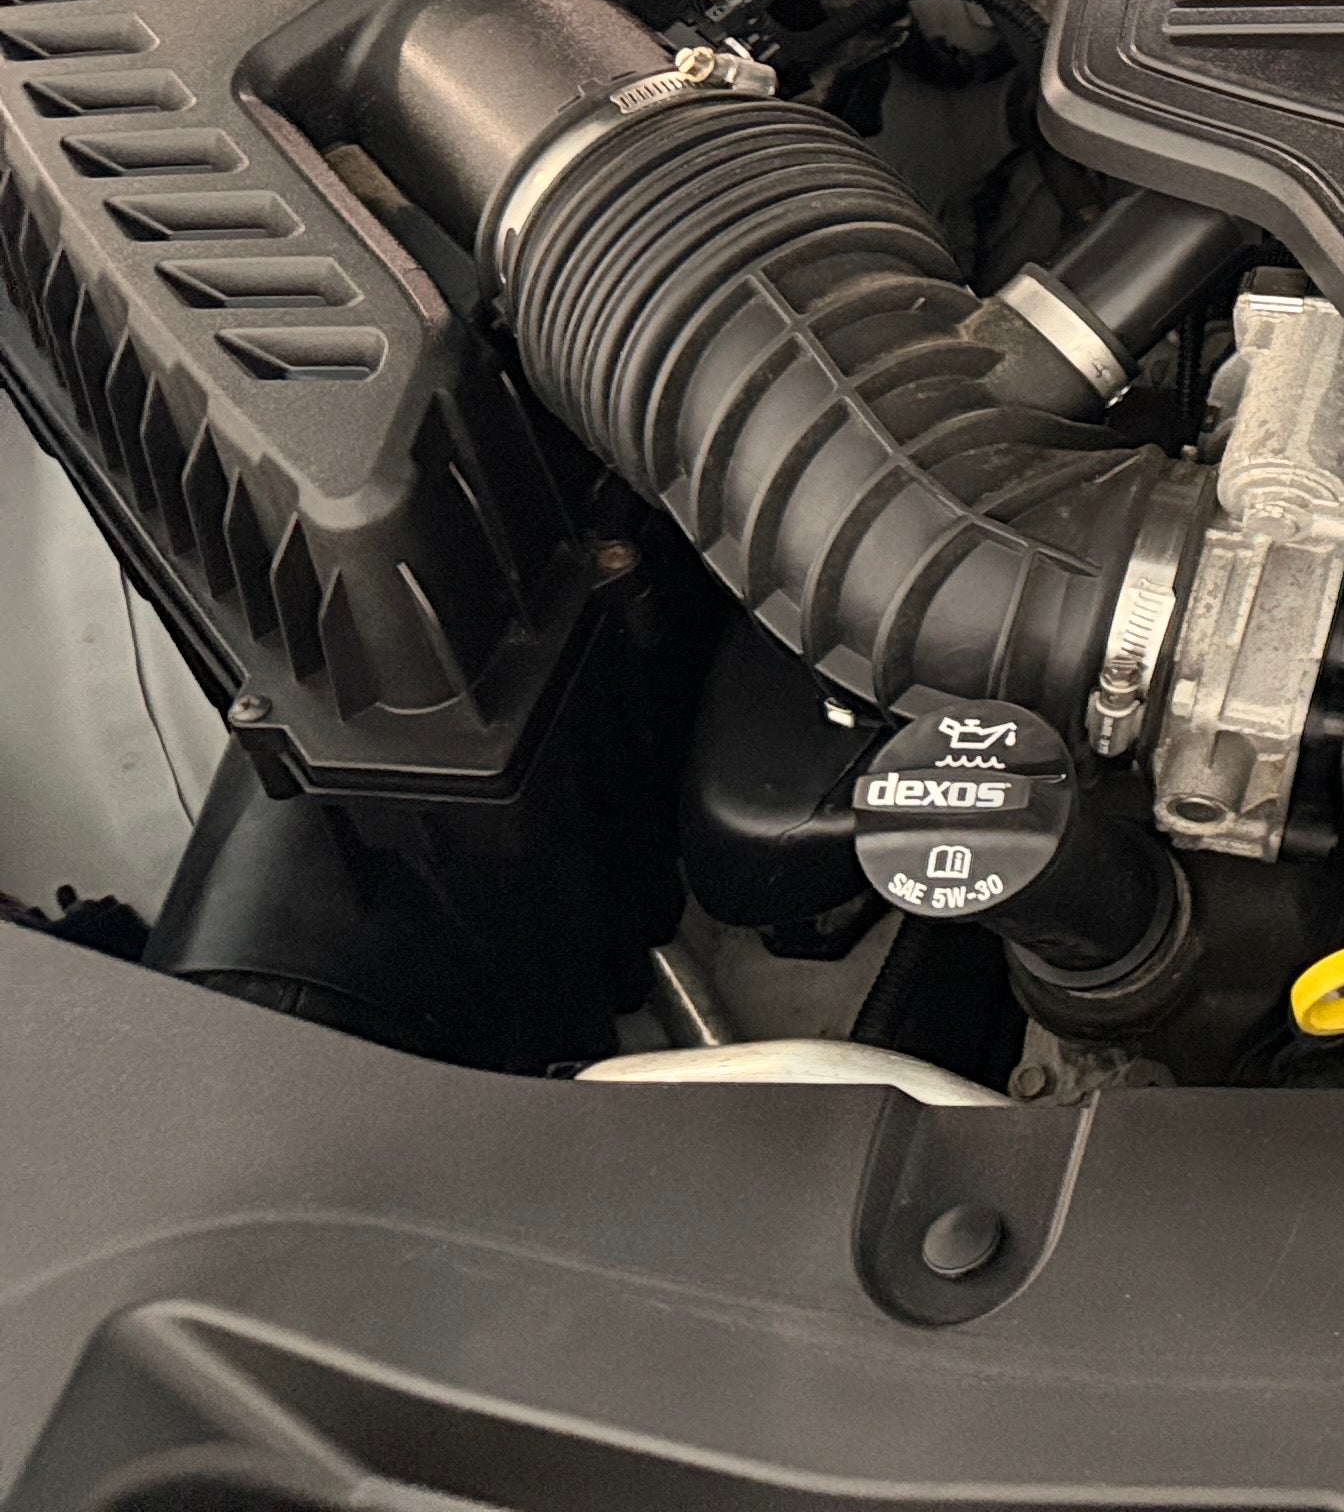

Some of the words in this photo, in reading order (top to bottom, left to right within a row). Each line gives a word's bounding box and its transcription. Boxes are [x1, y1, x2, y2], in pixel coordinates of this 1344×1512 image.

[867, 772, 1008, 808] dexos
[888, 873, 928, 905] SAE
[932, 874, 1003, 909] 5W-30
